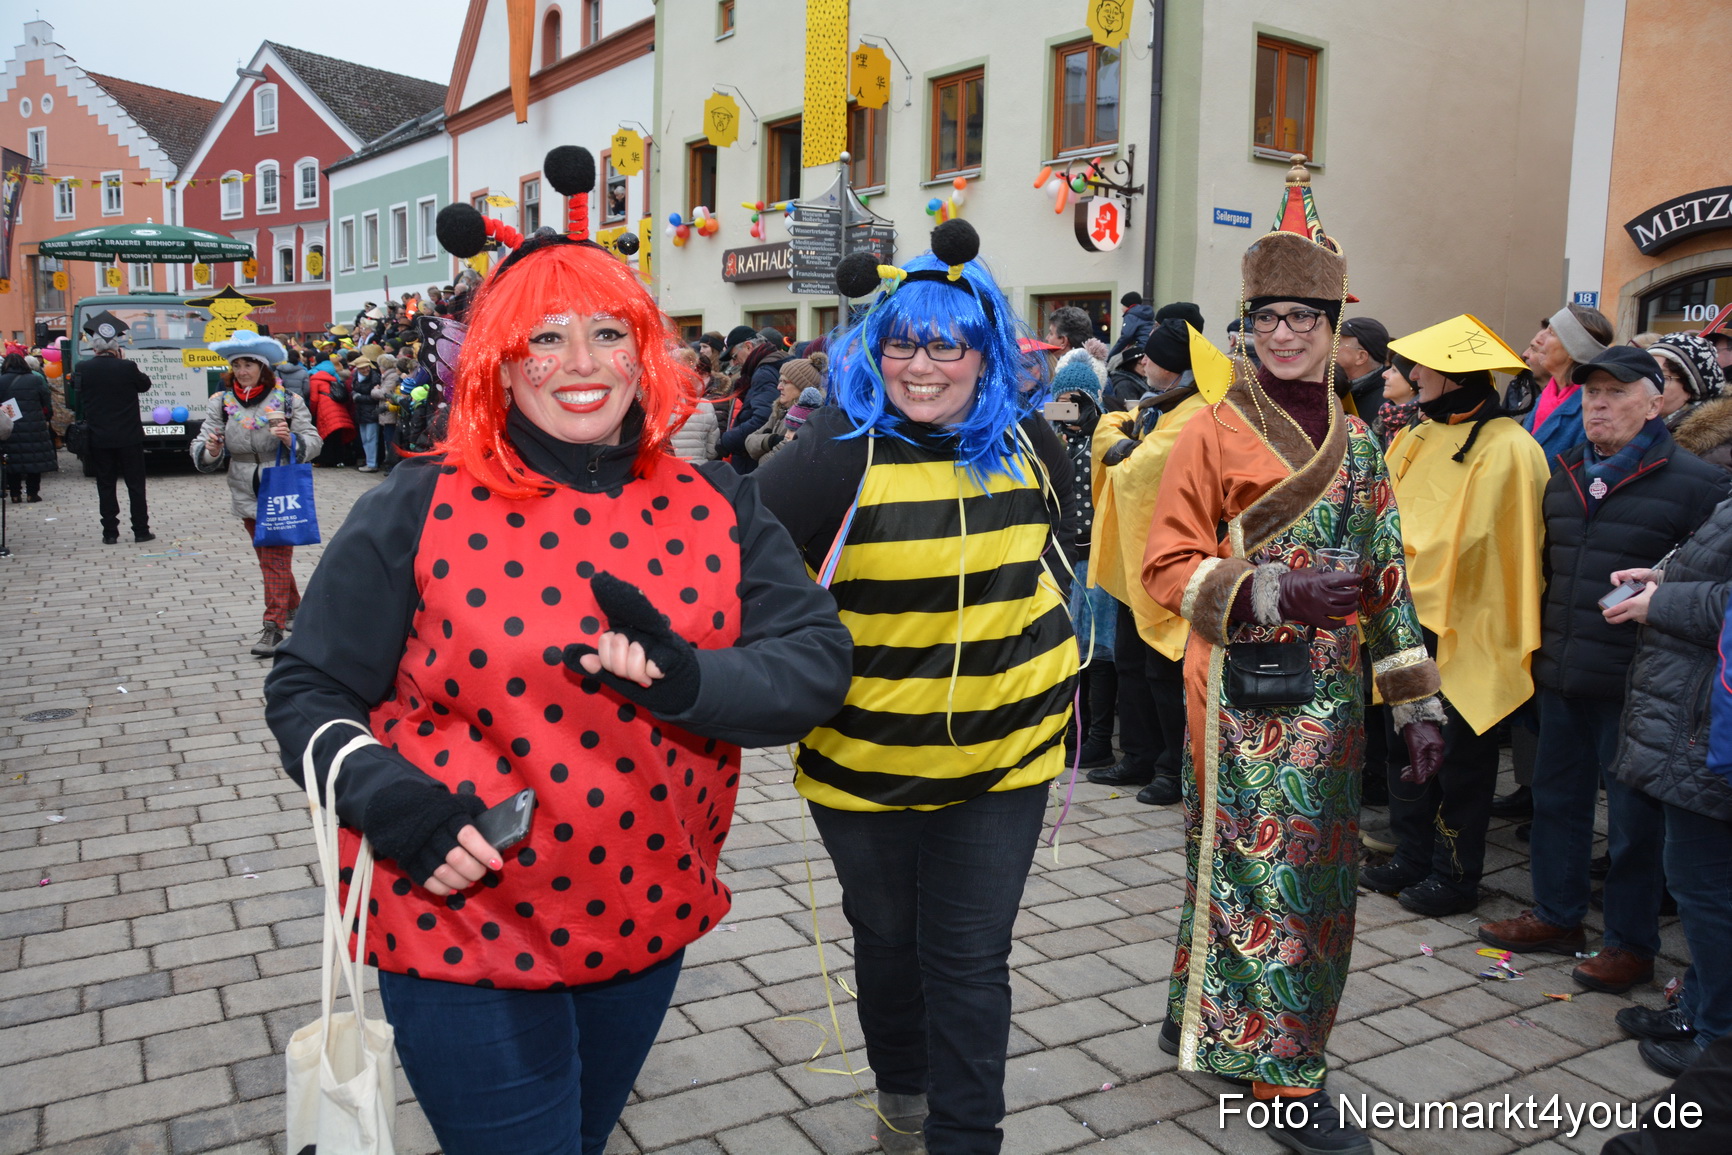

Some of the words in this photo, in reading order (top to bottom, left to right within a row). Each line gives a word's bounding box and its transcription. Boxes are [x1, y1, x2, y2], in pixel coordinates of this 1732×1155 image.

[1216, 210, 1250, 225] Seilergasse
[1633, 194, 1732, 248] METZ
[795, 227, 836, 236] Wassertretanlage
[796, 271, 834, 279] Franziskuspark
[1579, 293, 1592, 303] 18
[1682, 304, 1720, 322] 100
